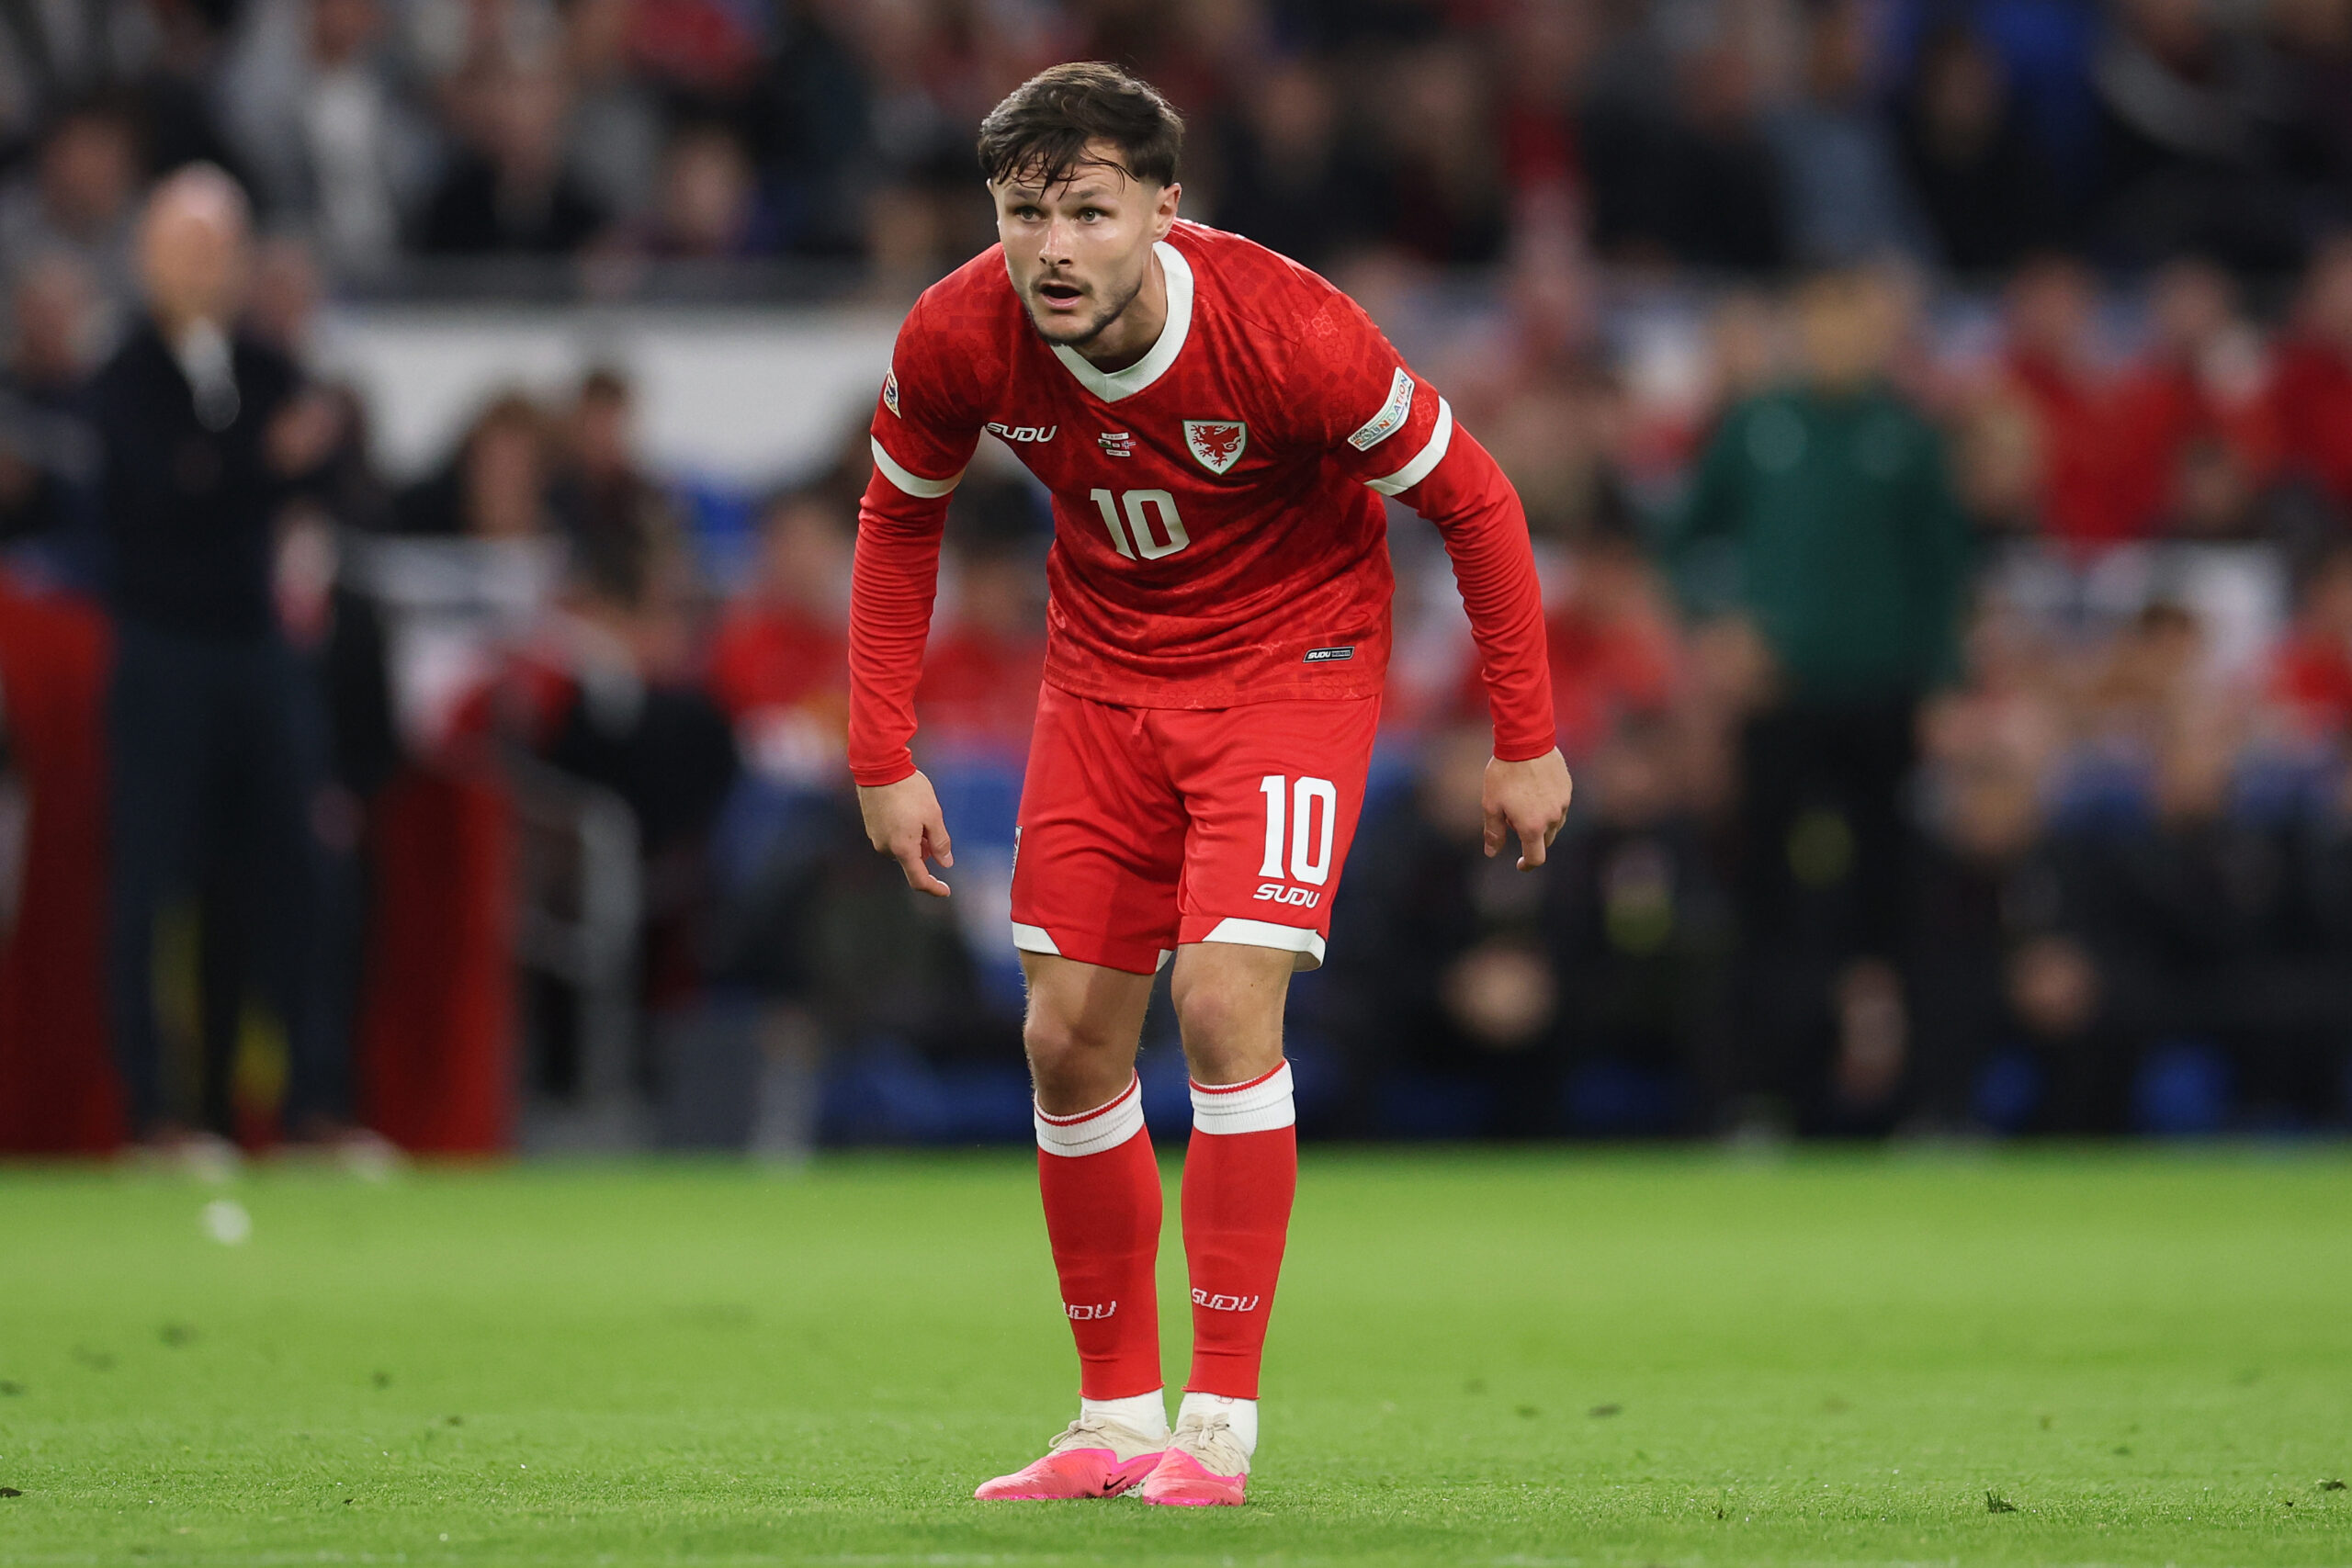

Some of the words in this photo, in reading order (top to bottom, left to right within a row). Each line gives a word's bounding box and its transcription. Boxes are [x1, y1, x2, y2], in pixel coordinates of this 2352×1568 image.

[1353, 374, 1409, 446] FOUNDATION
[987, 423, 1057, 443] SUDU
[1091, 488, 1190, 560] 10
[1307, 650, 1331, 660] SUDU
[1258, 774, 1337, 886] 10
[1252, 883, 1320, 908] SUDU
[1063, 1301, 1116, 1320] UDU
[1192, 1288, 1259, 1312] SUDU
